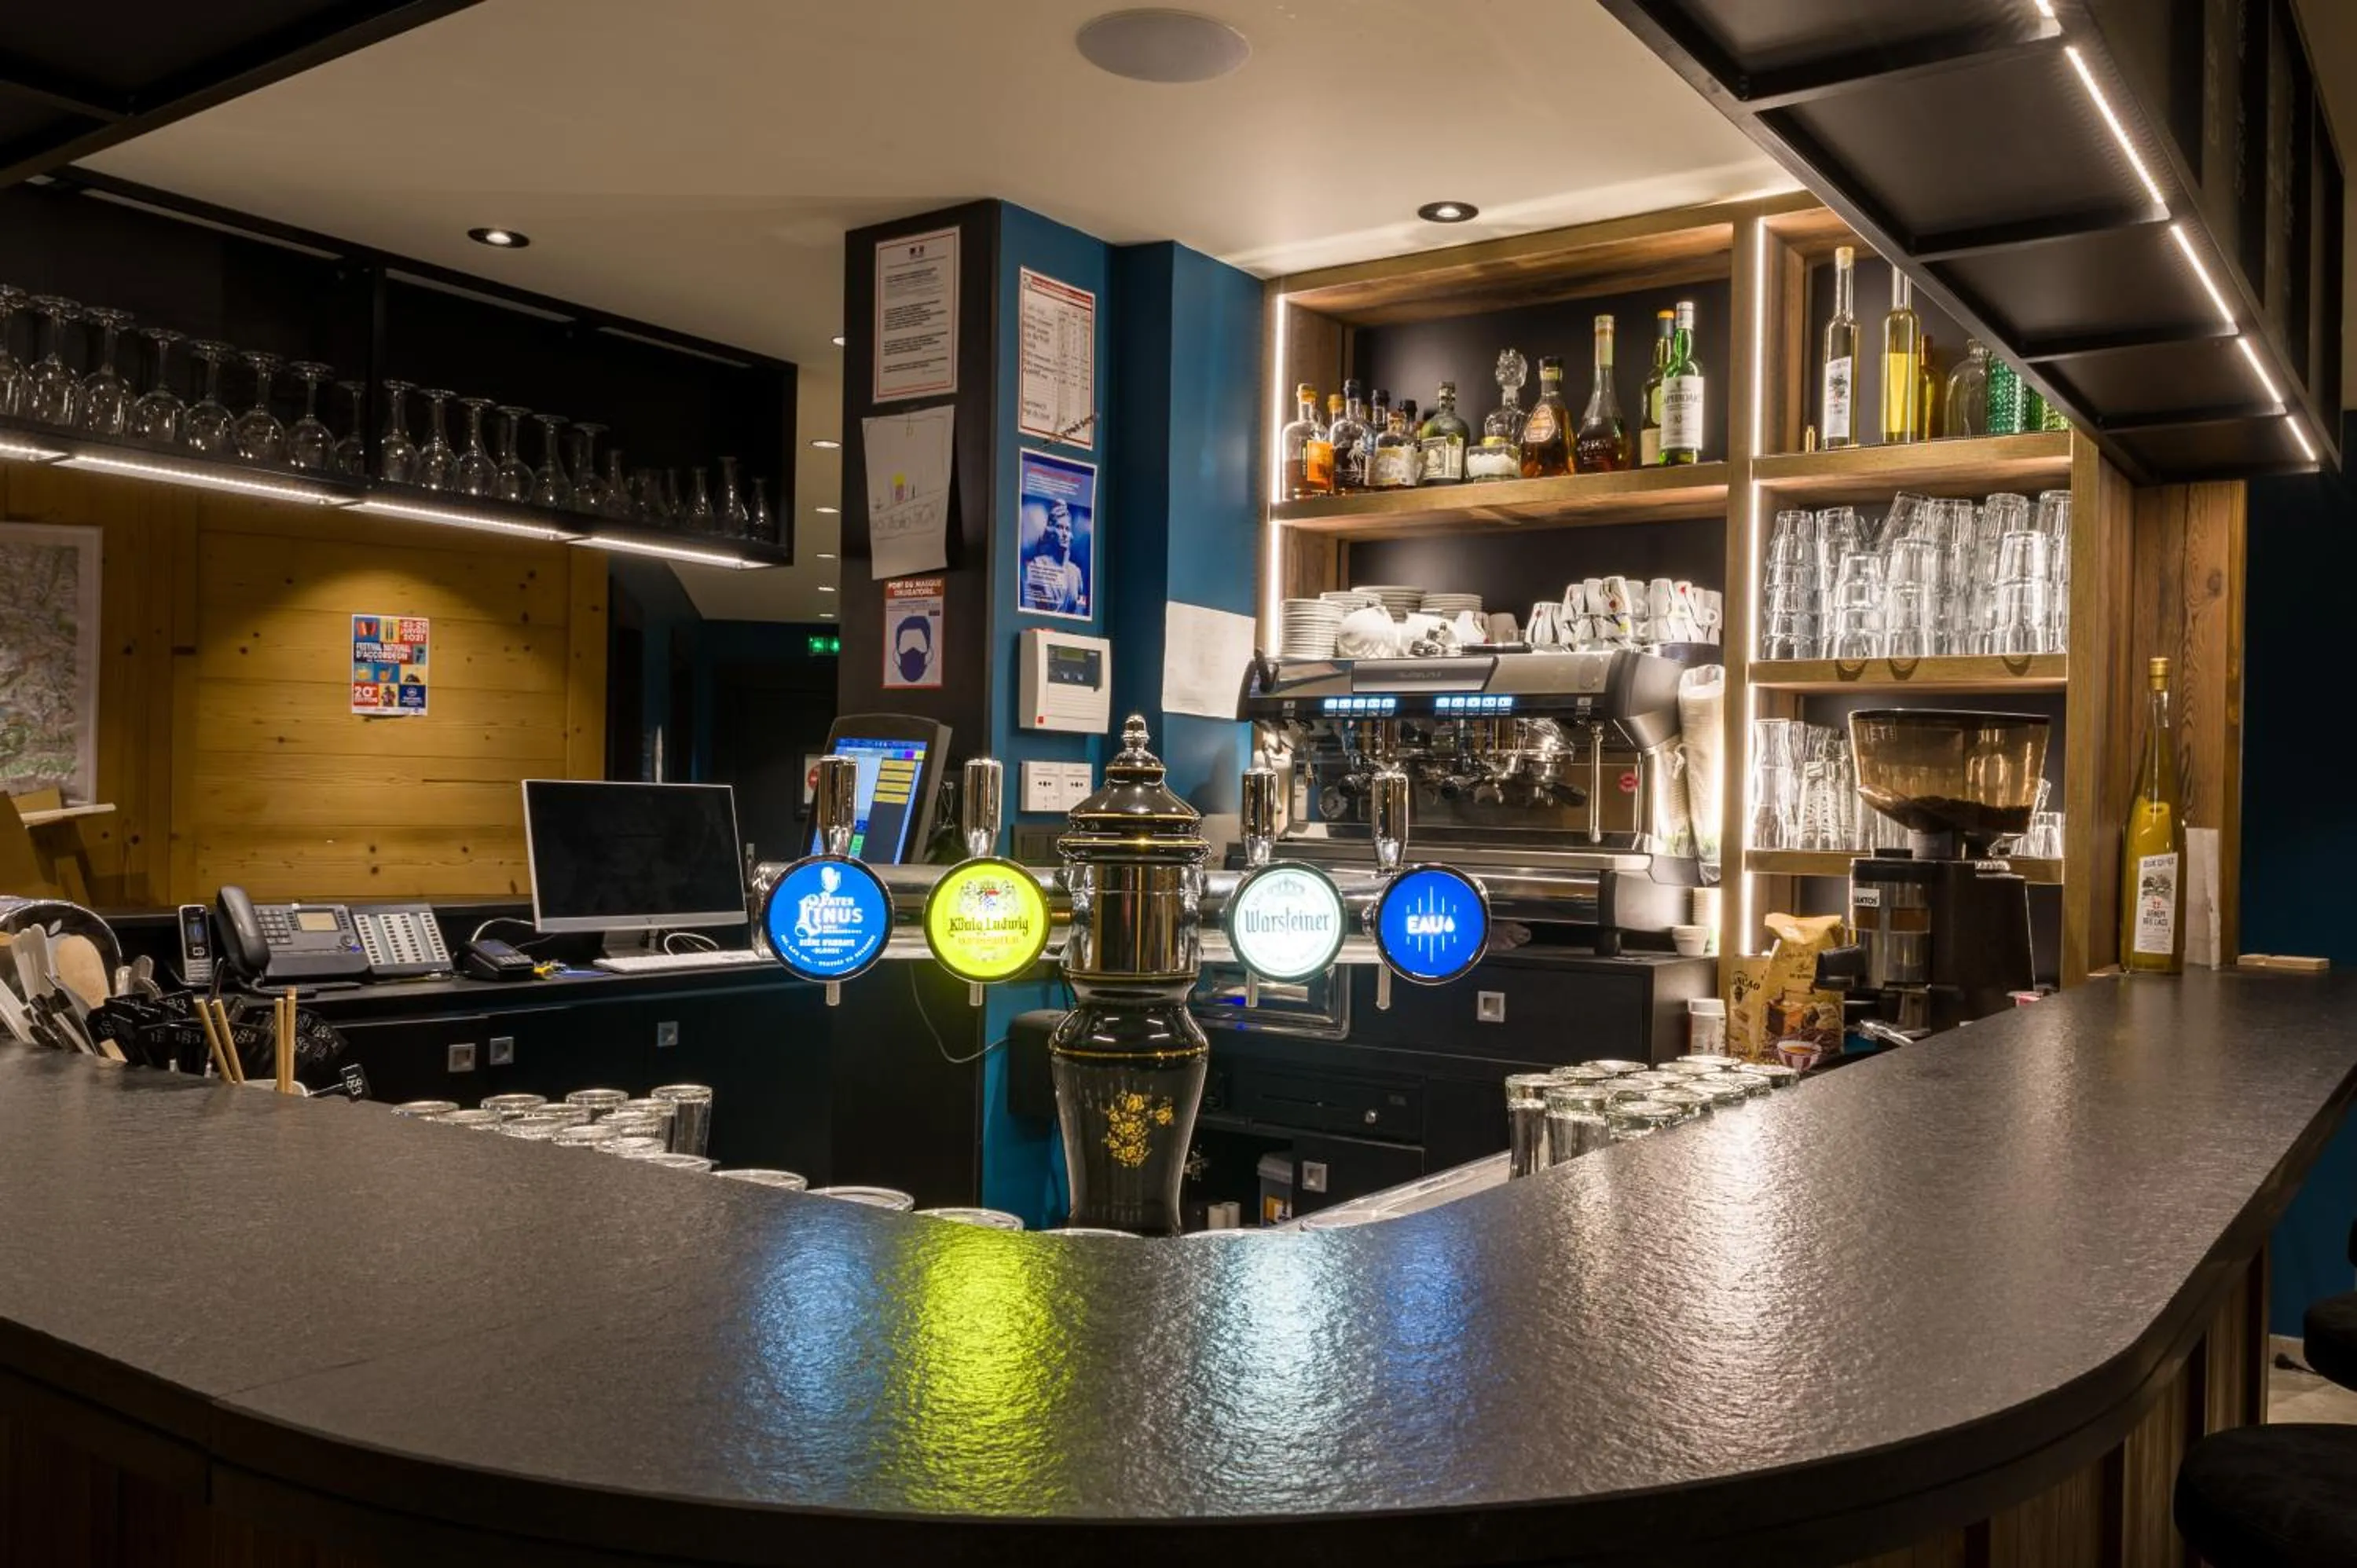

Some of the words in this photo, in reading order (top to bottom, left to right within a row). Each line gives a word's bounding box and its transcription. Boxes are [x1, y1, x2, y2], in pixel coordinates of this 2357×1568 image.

[986, 915, 1029, 938] Ludwig
[1244, 907, 1330, 935] Warsteiner
[1406, 915, 1443, 934] EAU
